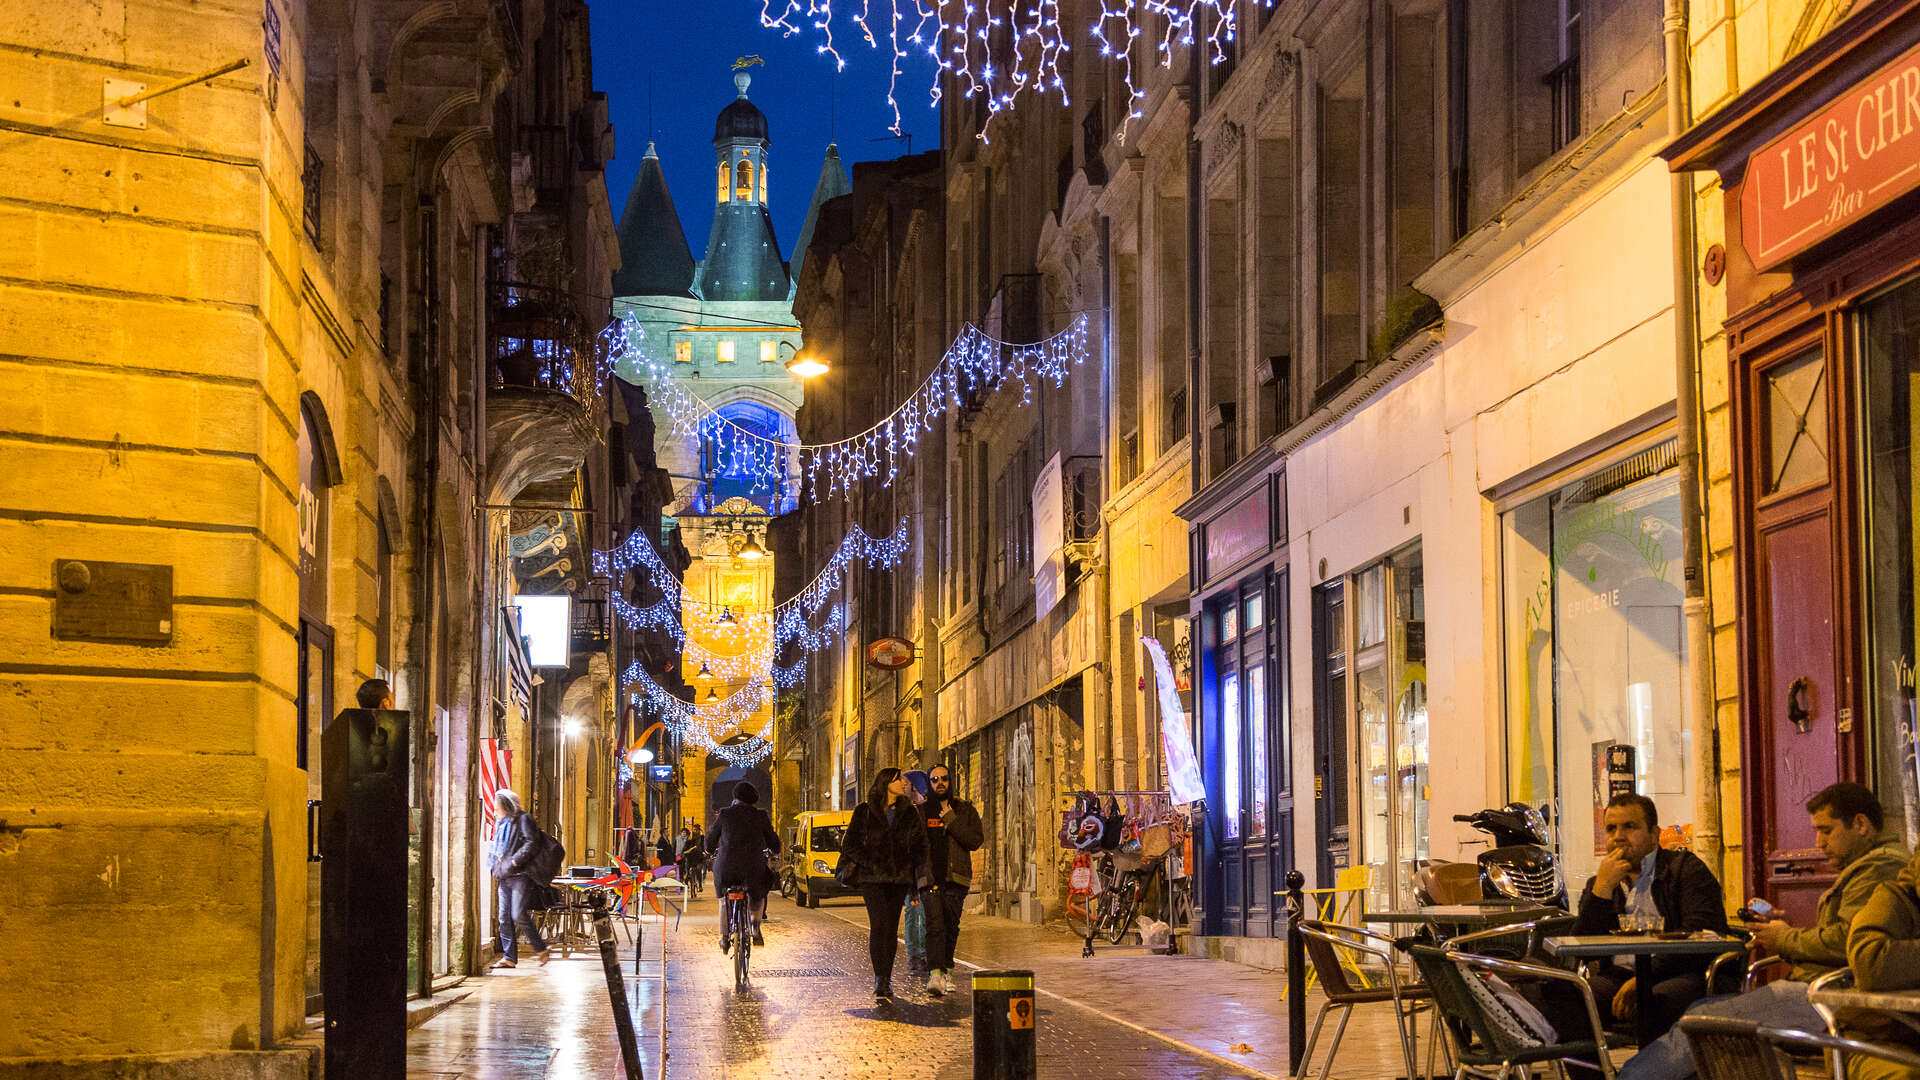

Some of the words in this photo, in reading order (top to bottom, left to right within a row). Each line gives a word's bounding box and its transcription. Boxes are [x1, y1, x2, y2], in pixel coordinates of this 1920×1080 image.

[1781, 132, 1818, 210] LE
[1825, 119, 1849, 182] St
[1856, 66, 1920, 160] CHR
[1824, 182, 1864, 226] Bar
